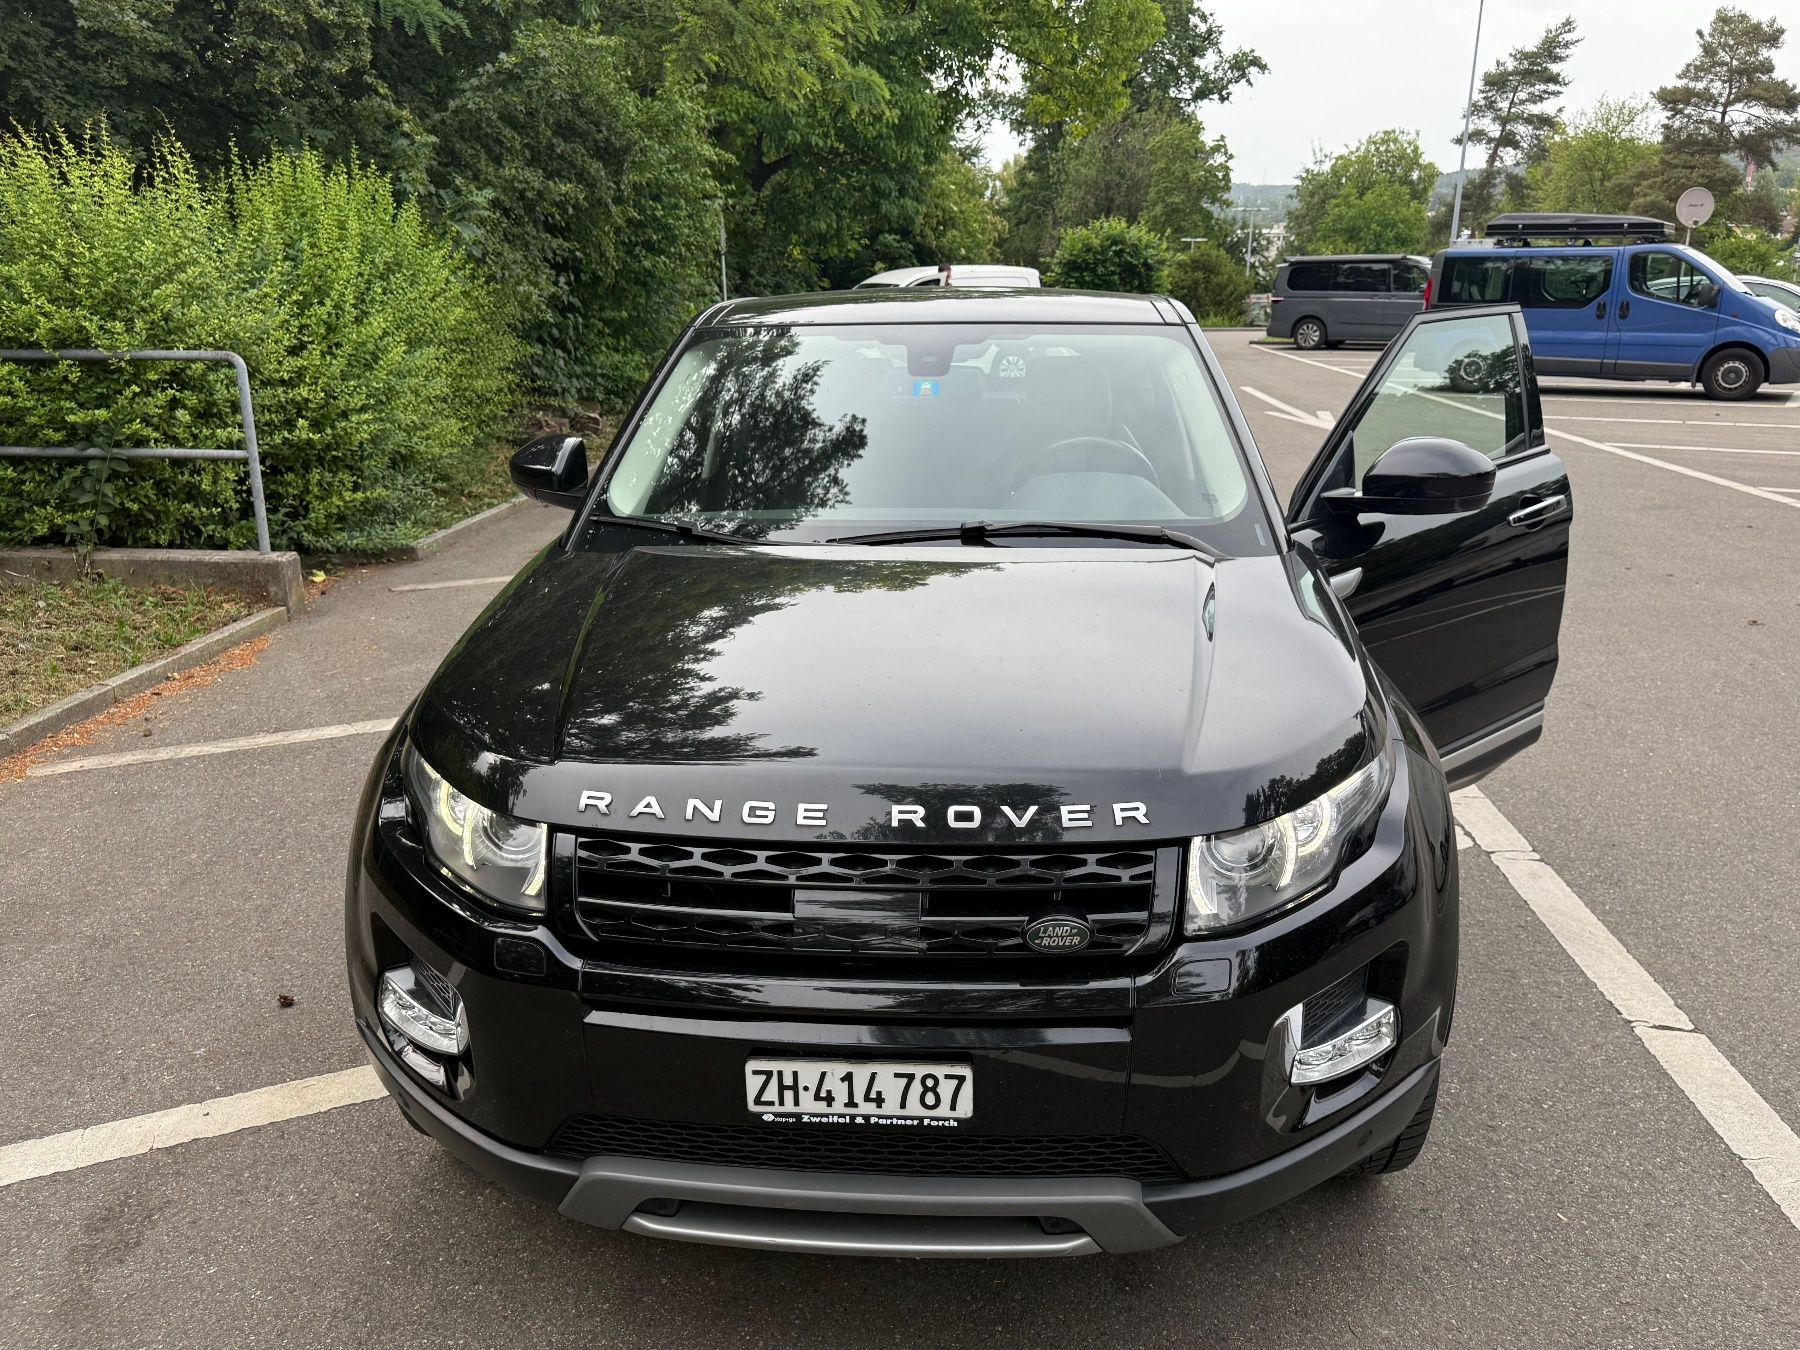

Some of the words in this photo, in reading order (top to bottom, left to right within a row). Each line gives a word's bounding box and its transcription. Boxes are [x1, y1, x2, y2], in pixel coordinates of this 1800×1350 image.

[577, 788, 828, 827] RANGE
[890, 800, 1151, 830] ROVER
[801, 1114, 850, 1124] Zweifel
[854, 1116, 866, 1124] &
[870, 1116, 919, 1126] Partner
[923, 1118, 958, 1127] Forch
